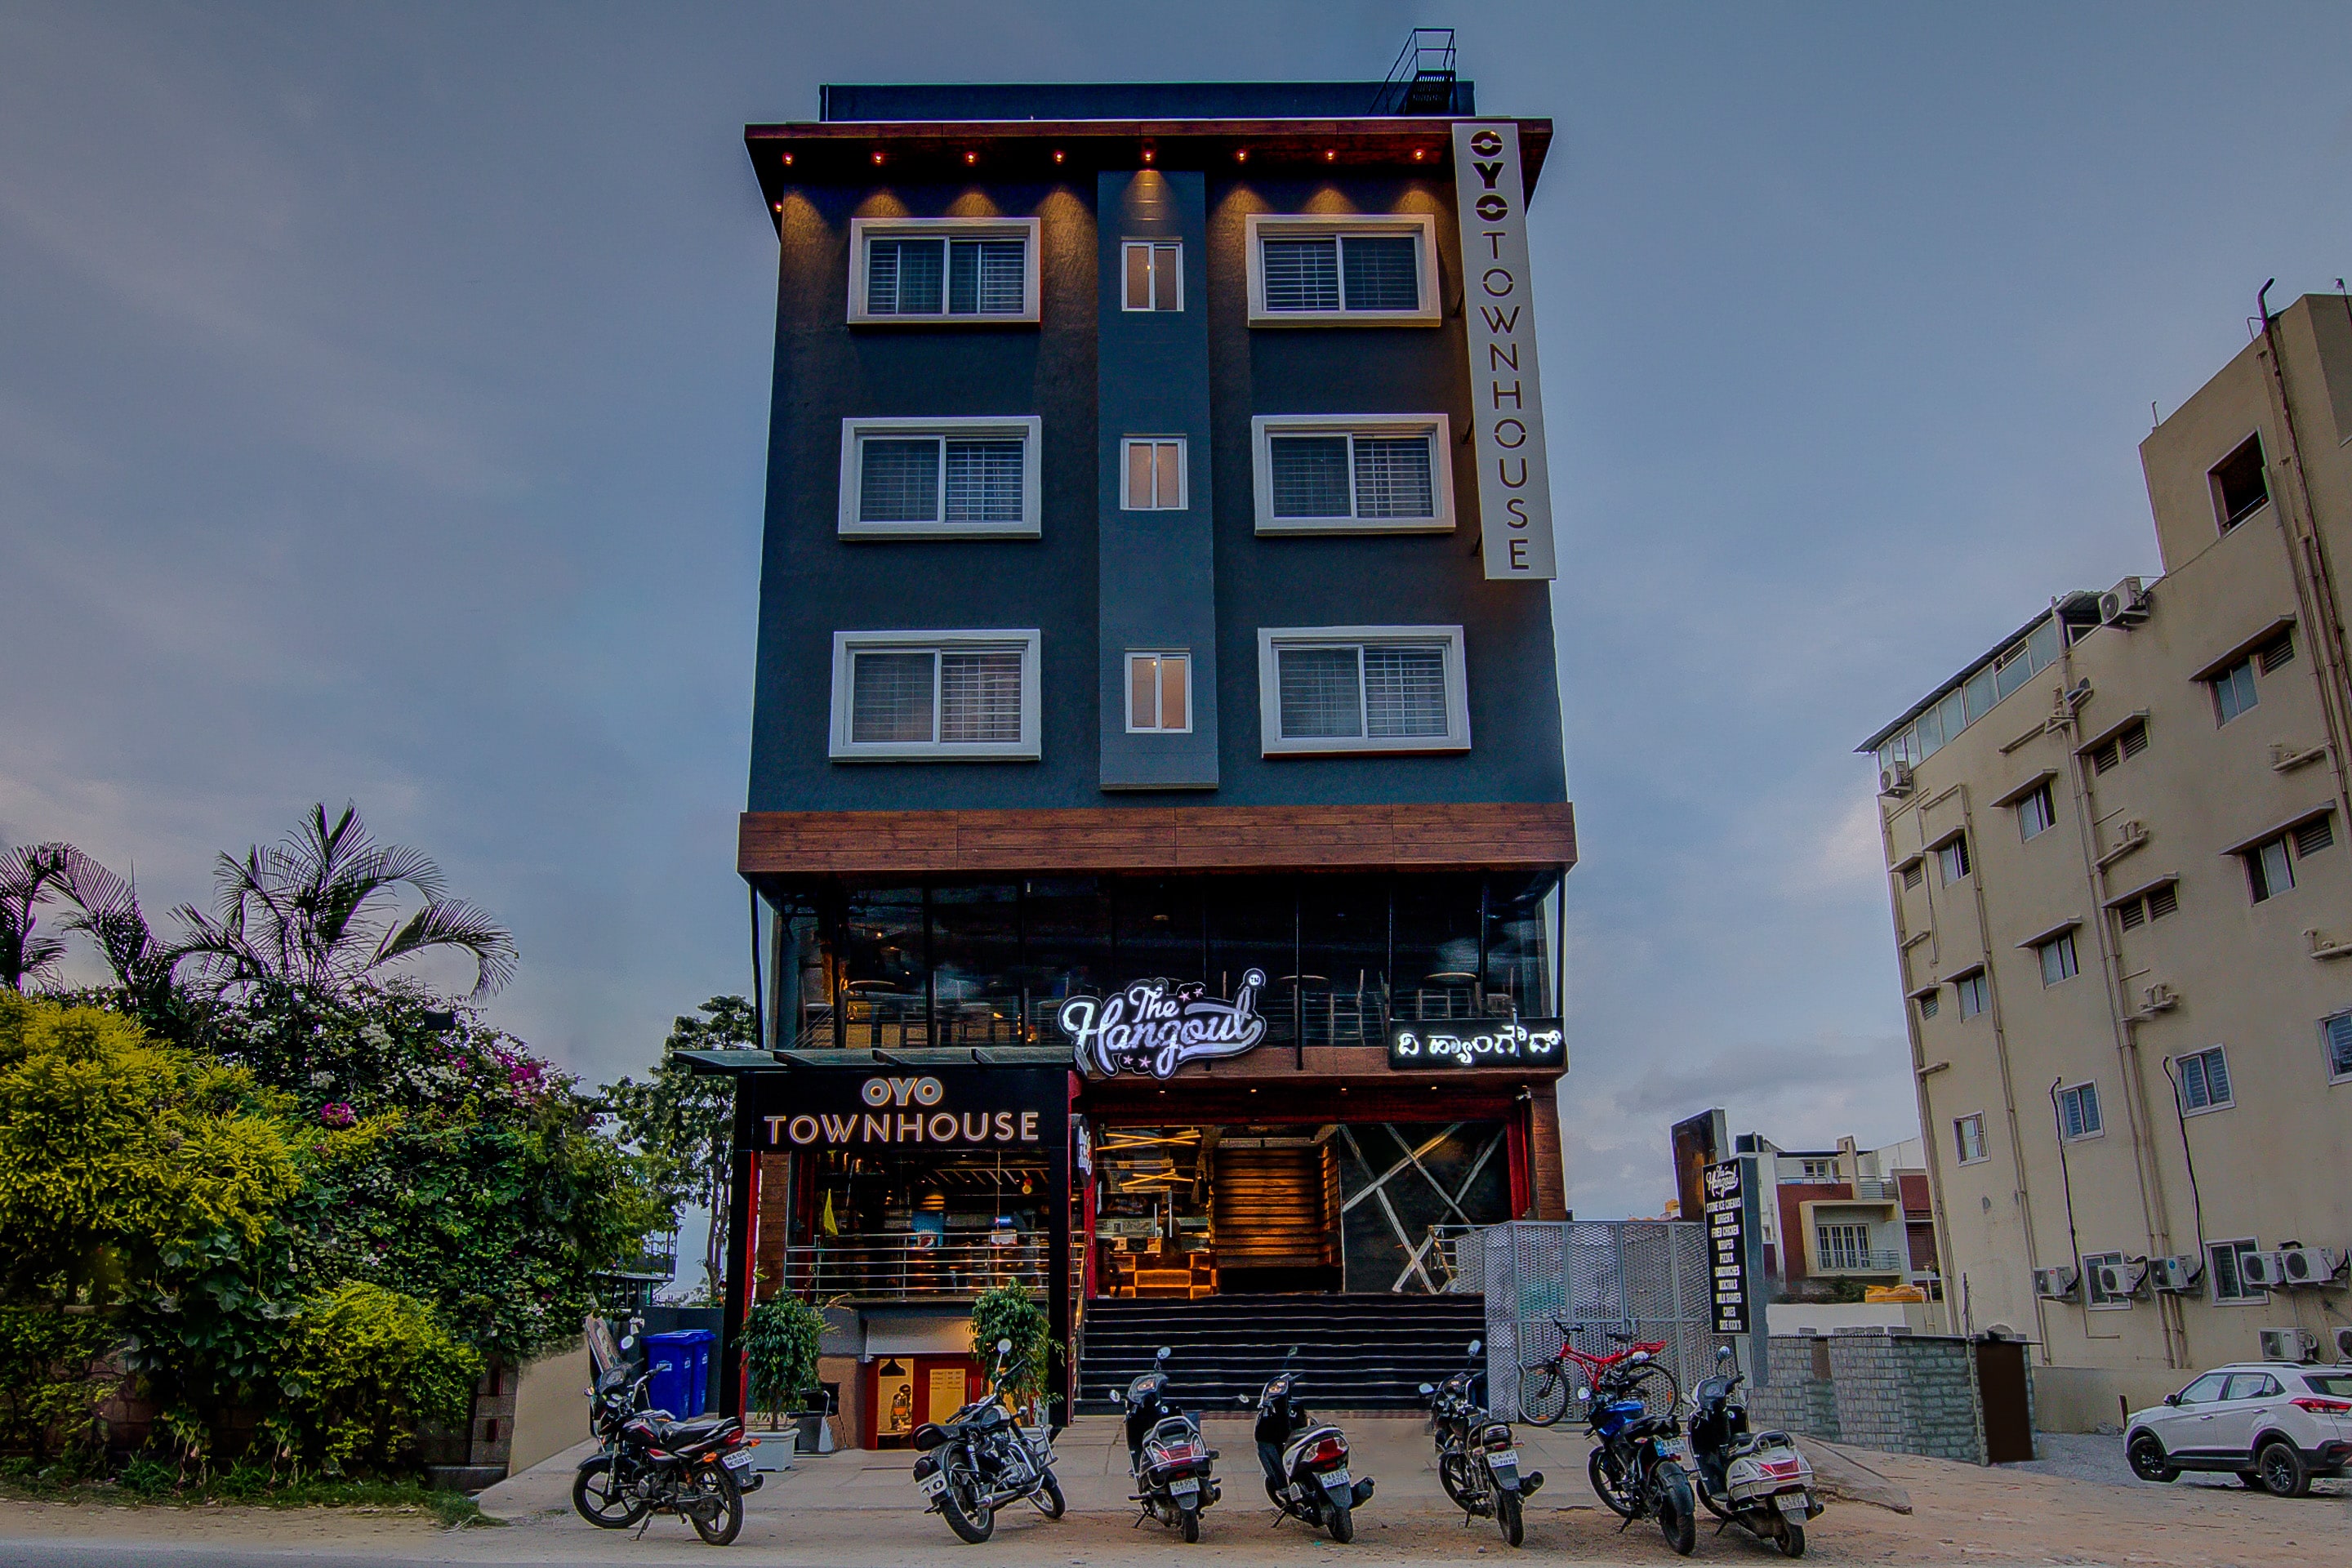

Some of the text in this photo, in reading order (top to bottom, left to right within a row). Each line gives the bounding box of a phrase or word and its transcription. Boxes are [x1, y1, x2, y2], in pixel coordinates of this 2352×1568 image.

[1470, 130, 1530, 570] OYO TOWNHOUSE
[1129, 984, 1180, 1022] The
[1062, 986, 1263, 1076] Hangout
[862, 1076, 943, 1107] OYO
[764, 1111, 1040, 1144] TOWNHOUSE
